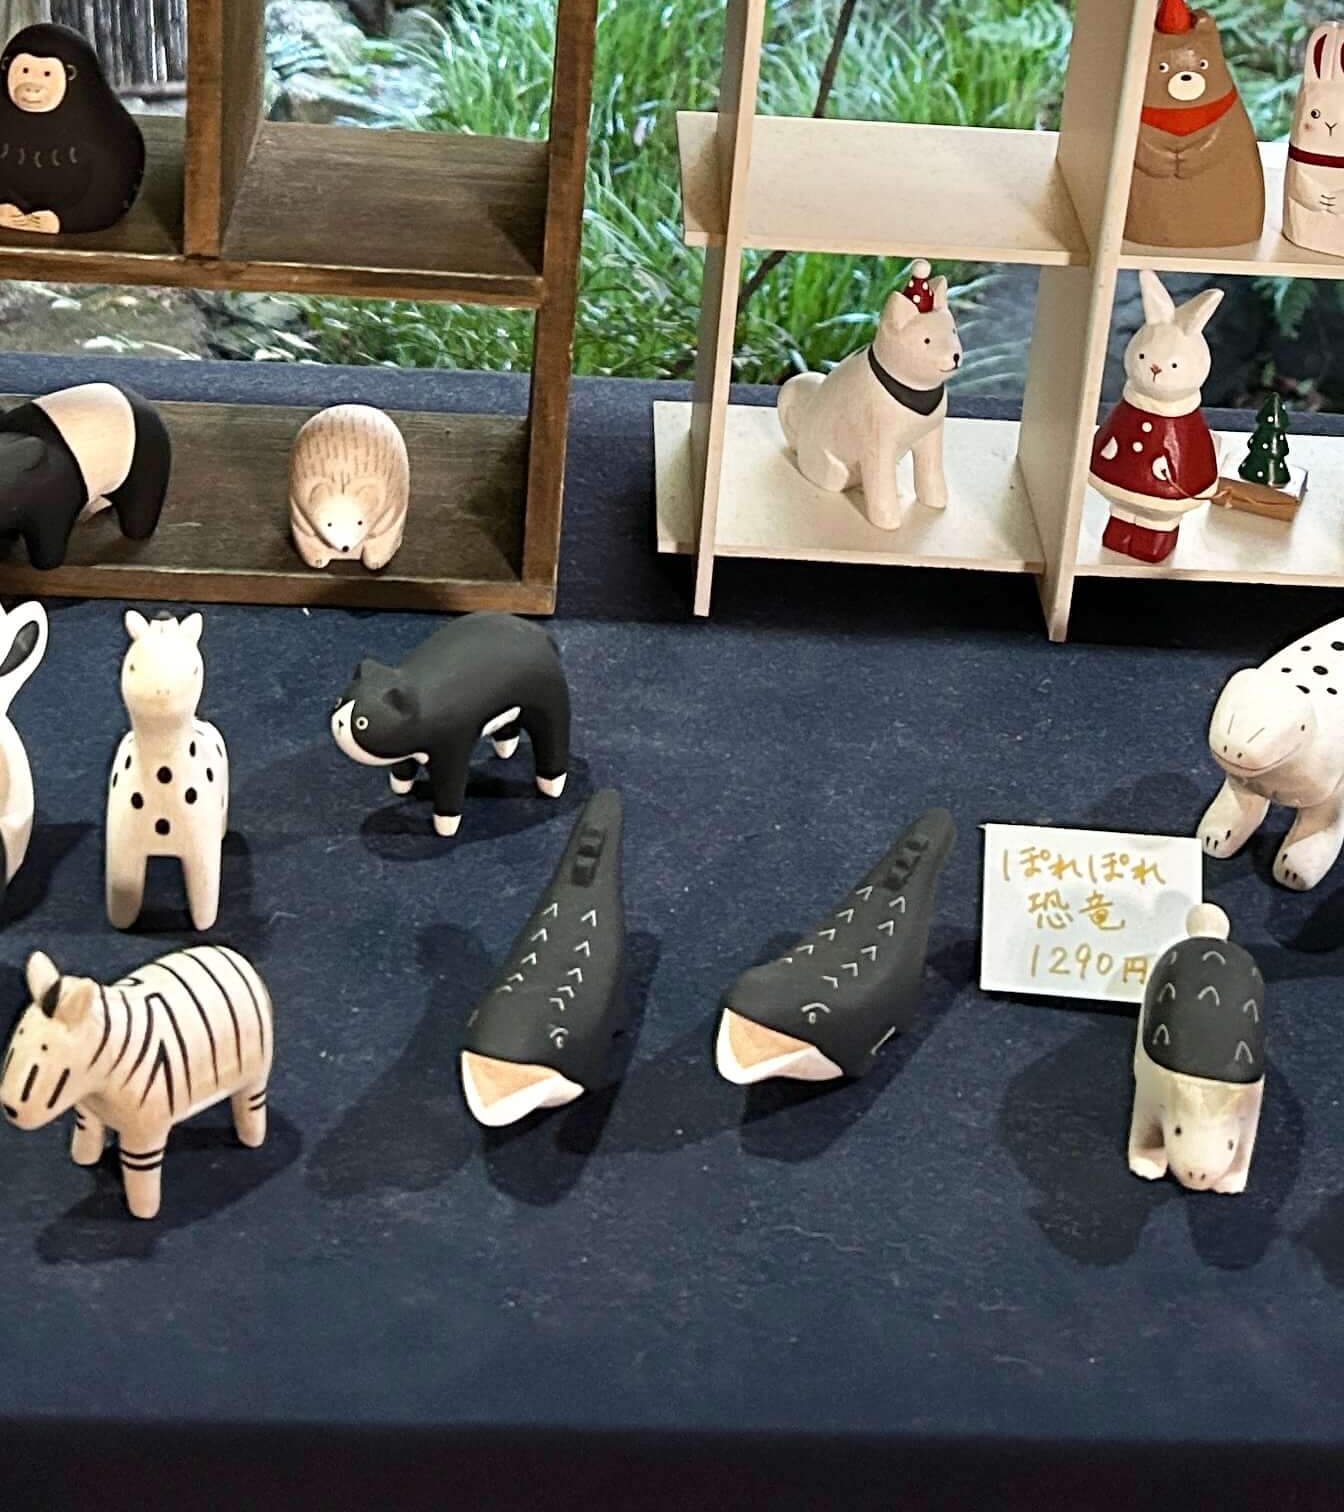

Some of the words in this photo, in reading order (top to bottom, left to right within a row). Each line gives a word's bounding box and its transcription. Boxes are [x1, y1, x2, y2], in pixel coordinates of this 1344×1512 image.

[1003, 846, 1166, 885] ぽれぽれ
[1027, 888, 1126, 931] 恐竜
[1030, 942, 1149, 985] 1290円
